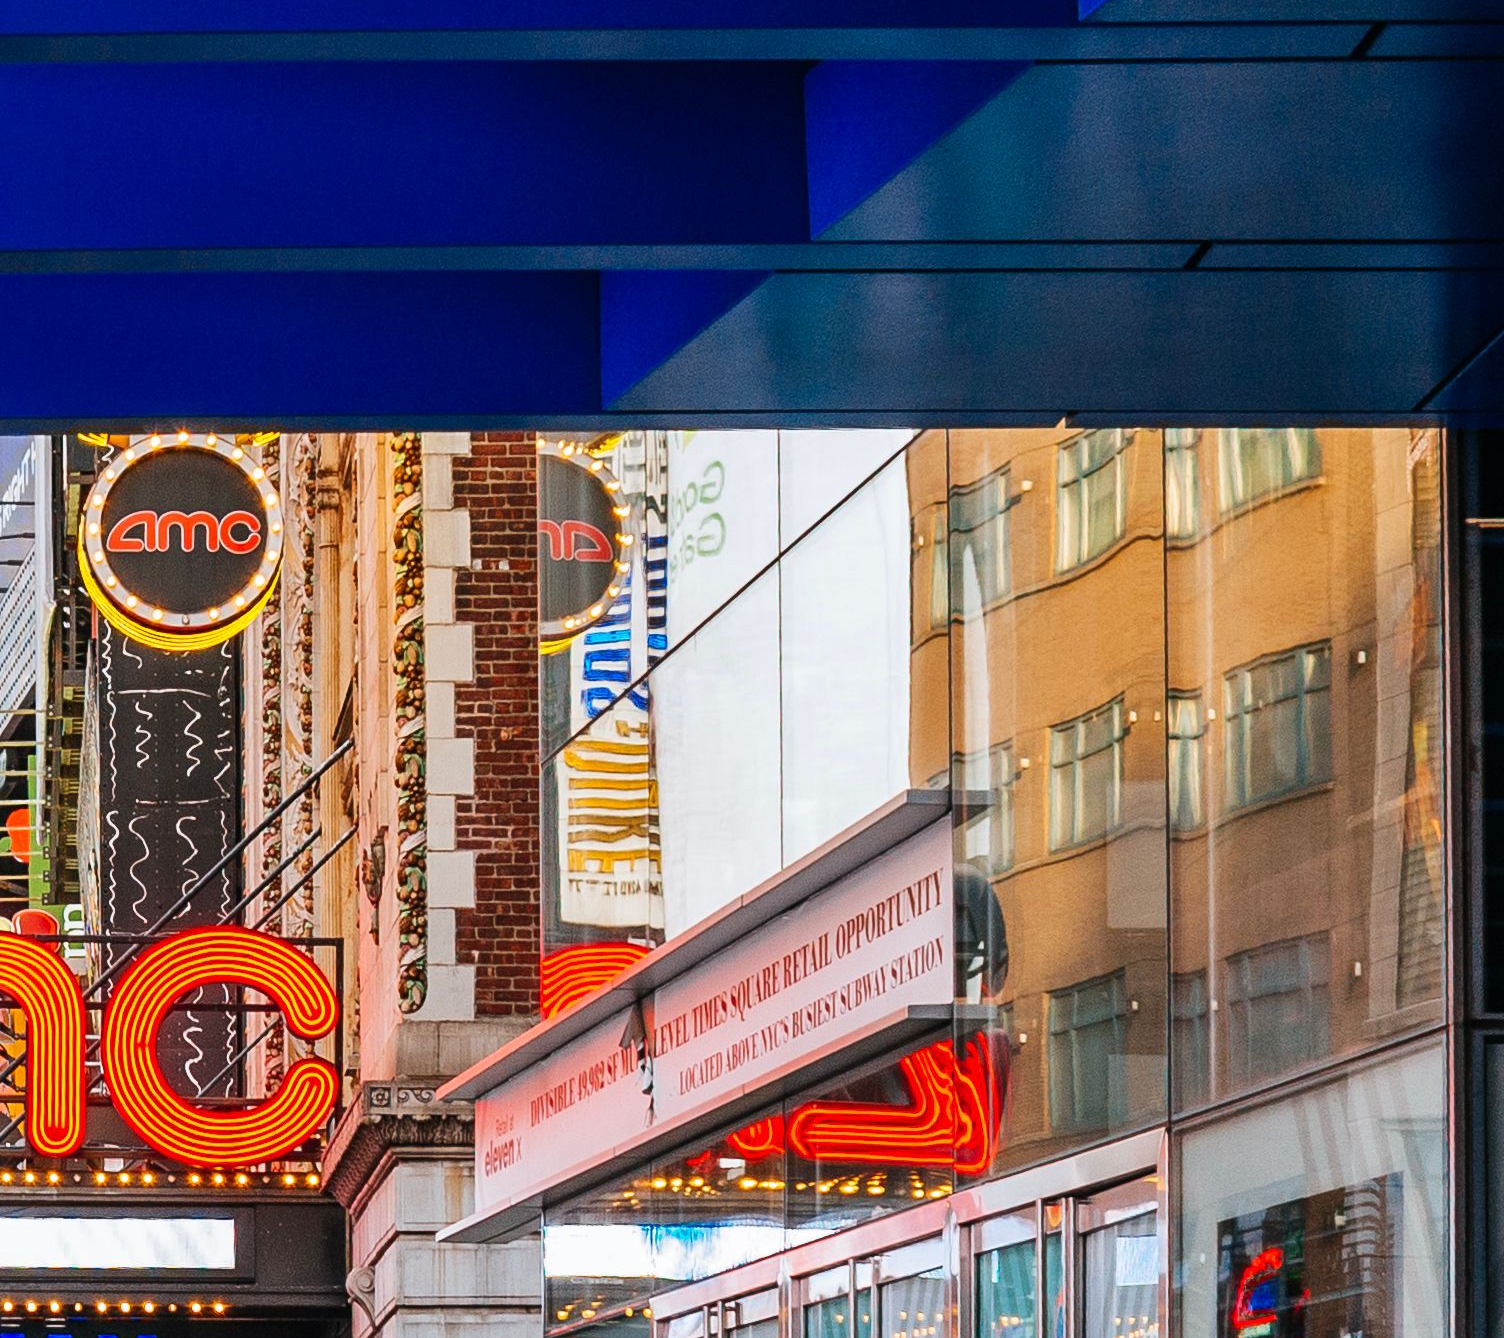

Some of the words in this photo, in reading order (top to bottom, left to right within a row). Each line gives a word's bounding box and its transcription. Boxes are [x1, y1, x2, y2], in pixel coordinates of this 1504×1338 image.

[106, 510, 262, 554] amc
[530, 1078, 576, 1129] DIVISIBLE
[692, 997, 728, 1038] TIMES
[730, 970, 781, 1023] SQUARE
[782, 942, 832, 994] RETAIL
[836, 867, 944, 959] OPPORTUNITY
[679, 1050, 723, 1096] LOCATED
[725, 1036, 758, 1075] ABOVE
[791, 993, 837, 1044] BUSIEST
[840, 973, 888, 1017] SUBWAY
[891, 935, 946, 990] STATION
